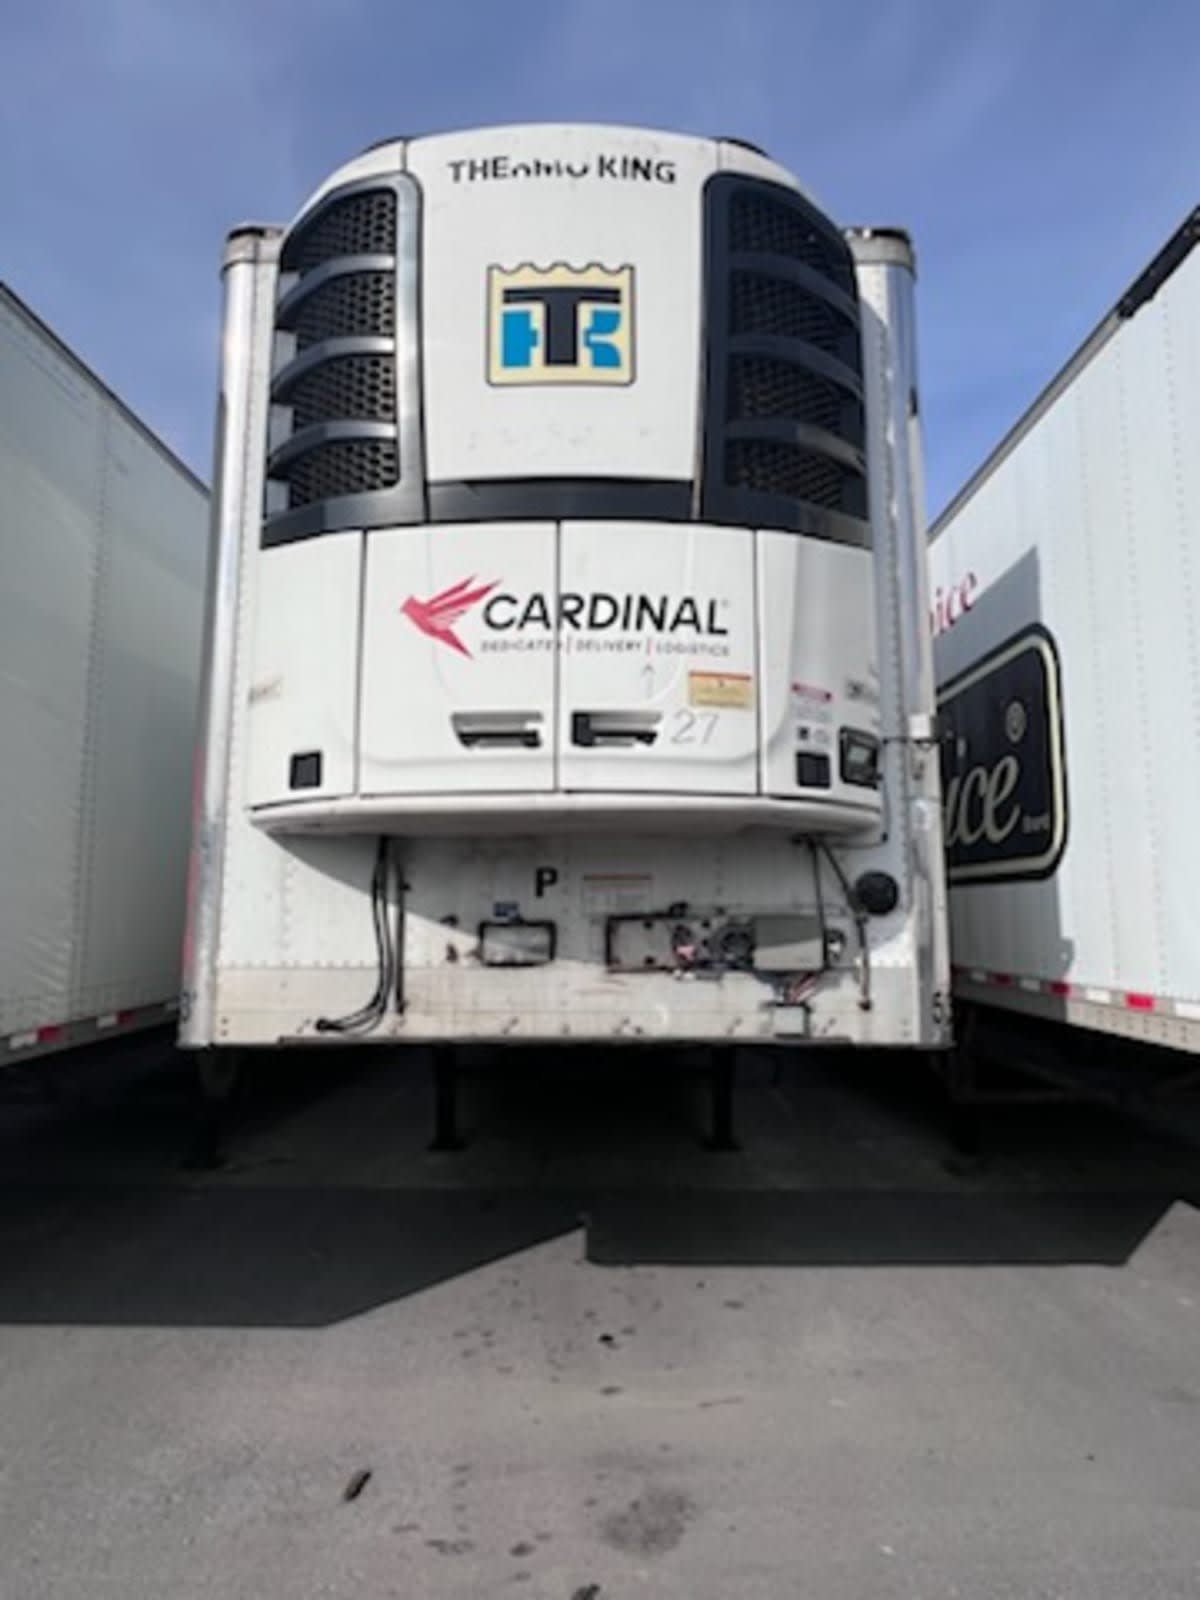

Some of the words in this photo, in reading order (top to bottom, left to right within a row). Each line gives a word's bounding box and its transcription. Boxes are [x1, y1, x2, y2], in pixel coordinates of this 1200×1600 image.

[598, 154, 676, 184] KING
[482, 592, 729, 636] CARDINAL
[576, 639, 641, 651] DELIVERY
[670, 708, 720, 745] 27
[535, 866, 558, 898] P
